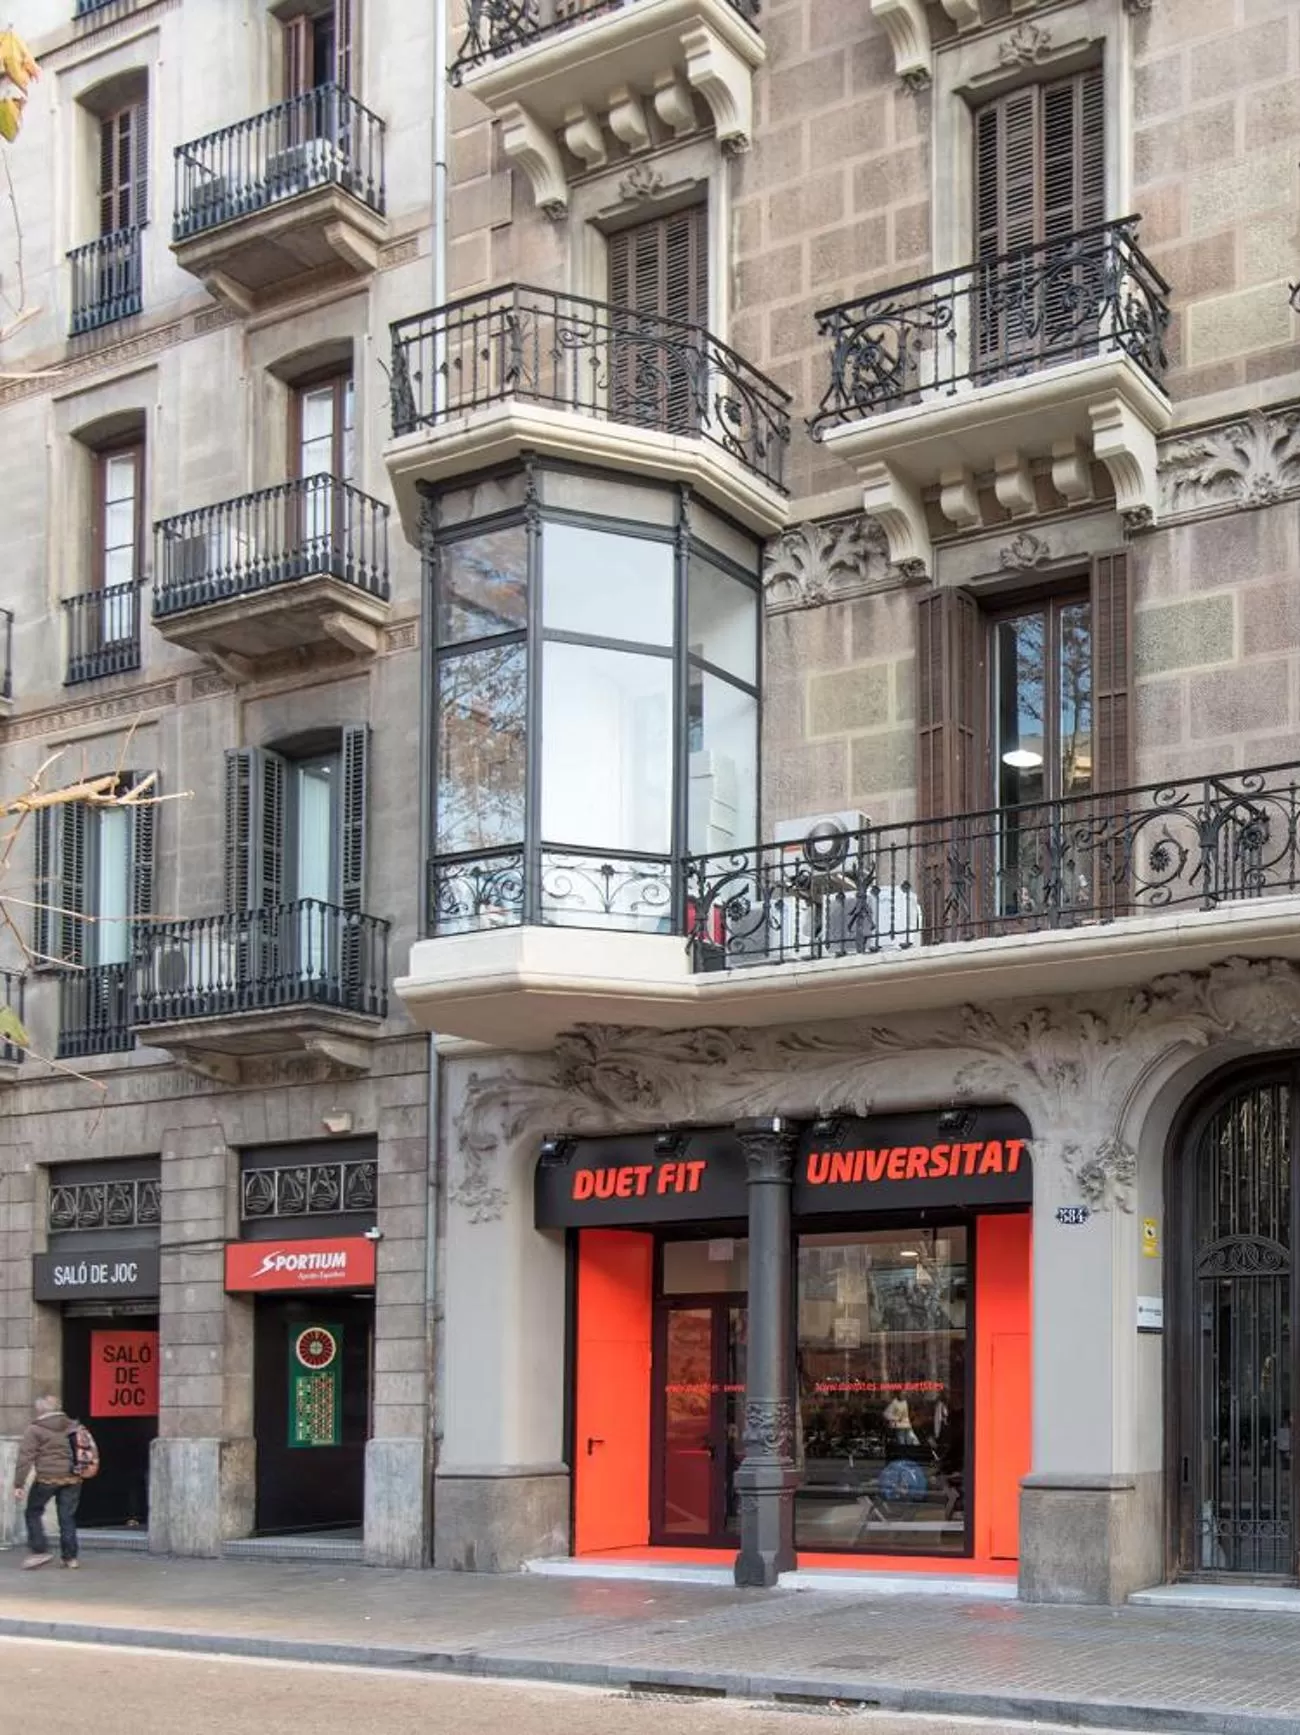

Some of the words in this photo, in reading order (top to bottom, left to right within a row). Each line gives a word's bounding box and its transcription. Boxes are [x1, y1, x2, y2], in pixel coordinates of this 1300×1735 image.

[806, 1138, 1026, 1185] UNIVERSITAT
[572, 1166, 653, 1200] DUET
[656, 1160, 708, 1194] FIT
[54, 1261, 88, 1285] SALÓ
[91, 1265, 108, 1283] DE
[111, 1263, 138, 1283] JOC
[248, 1250, 347, 1278] SPORTIUM
[103, 1342, 152, 1363] SALÓ
[115, 1367, 139, 1384] DE
[108, 1388, 146, 1406] JOC
